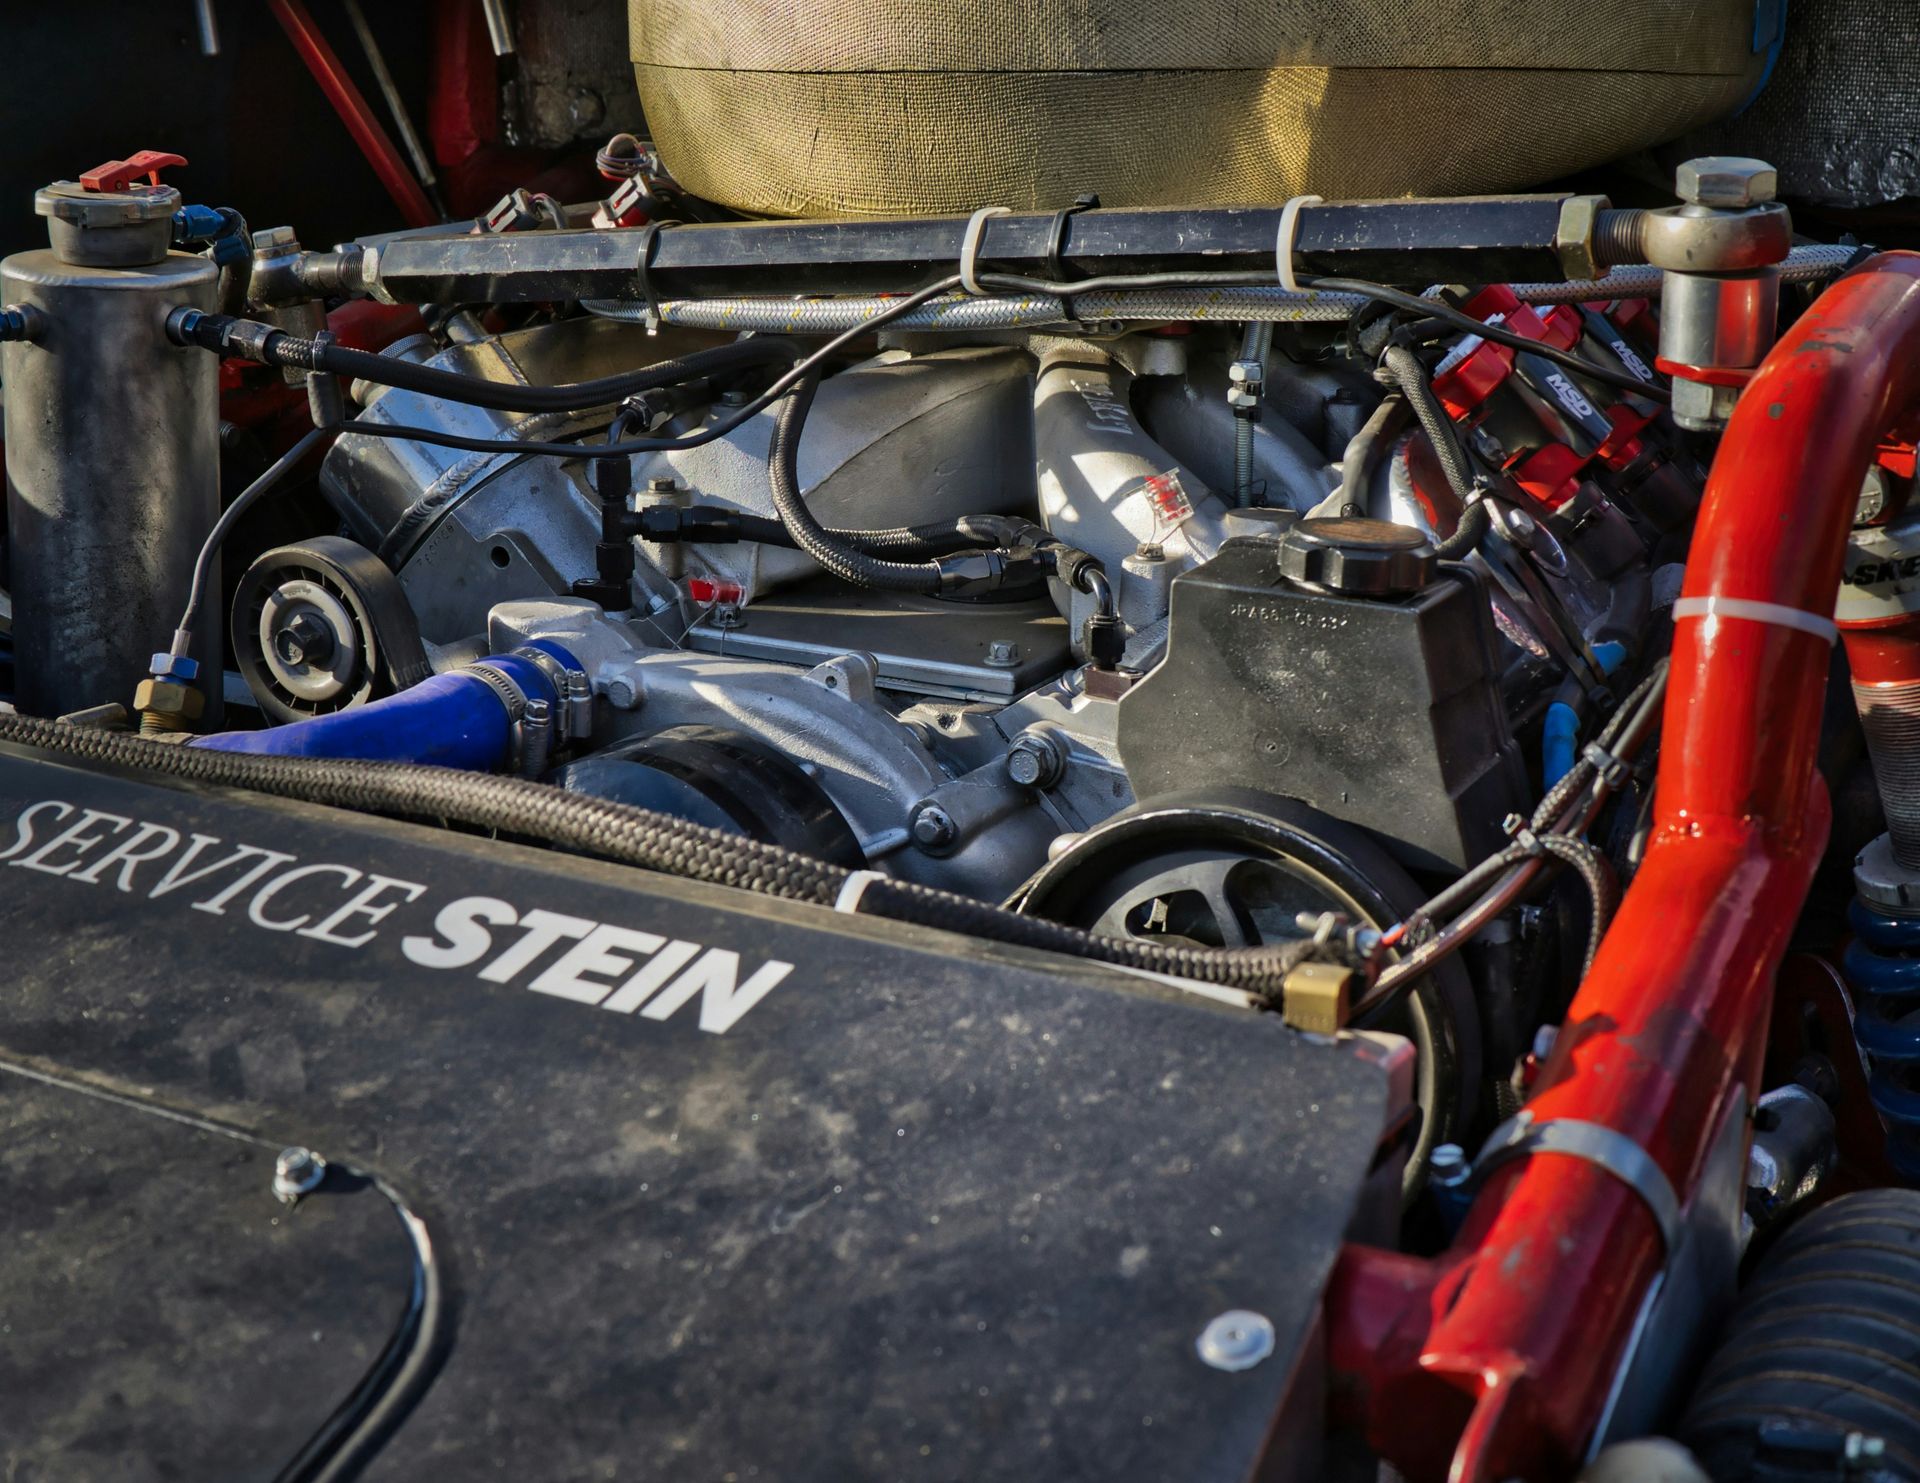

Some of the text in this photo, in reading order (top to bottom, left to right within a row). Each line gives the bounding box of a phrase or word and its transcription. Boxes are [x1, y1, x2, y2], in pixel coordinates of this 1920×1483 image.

[1611, 340, 1653, 380] MSD
[1545, 373, 1593, 417] MSD
[0, 800, 795, 1034] SERVICE STEIN
